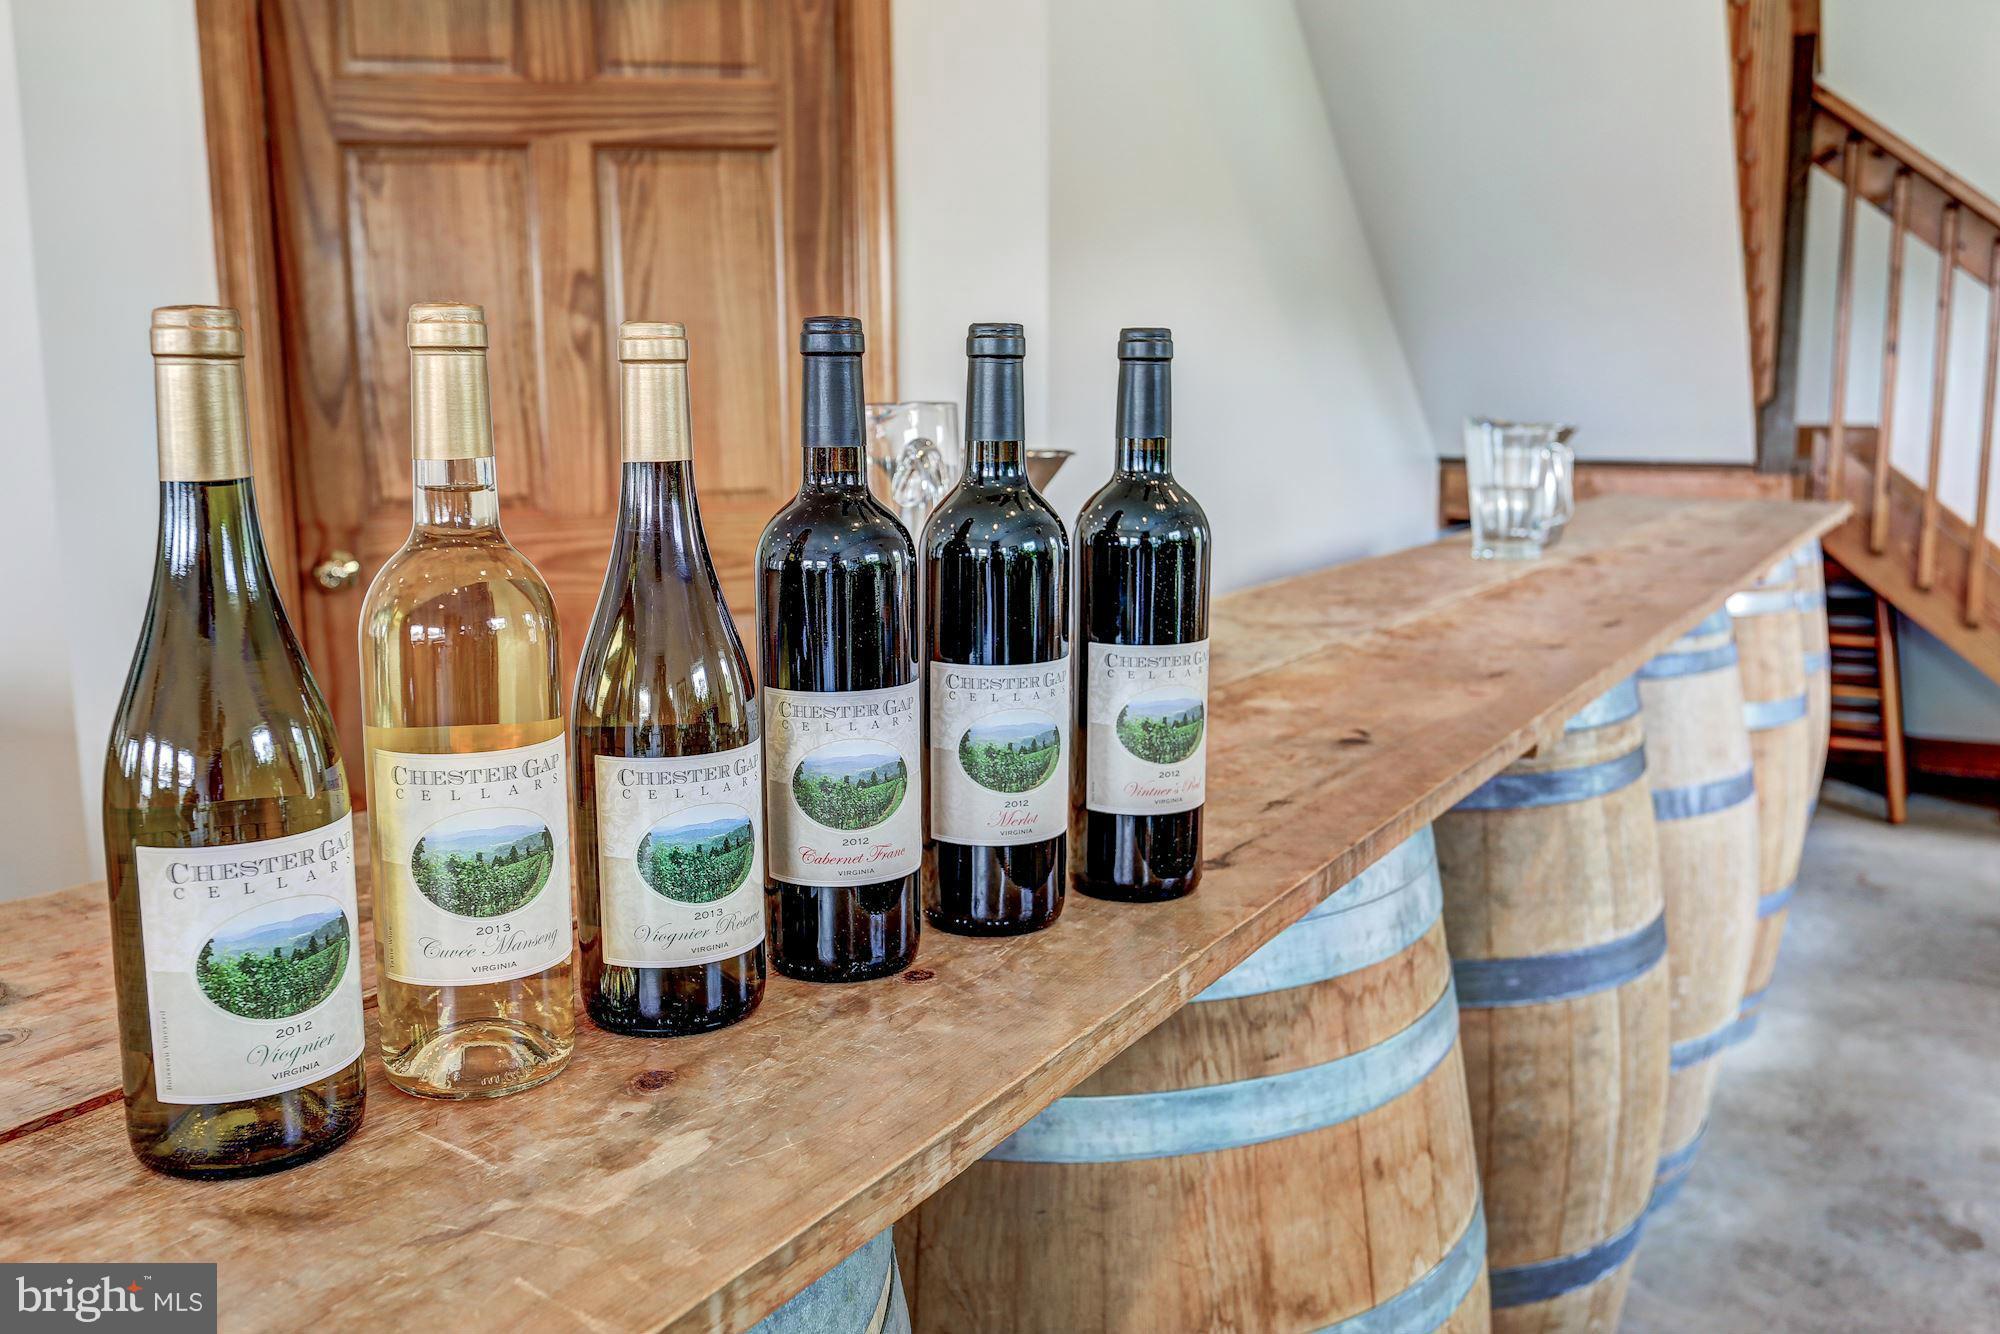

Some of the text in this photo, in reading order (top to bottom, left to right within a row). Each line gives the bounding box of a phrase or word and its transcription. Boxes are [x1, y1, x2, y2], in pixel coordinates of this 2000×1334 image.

[1104, 652, 1191, 668] CHESTER
[945, 673, 1040, 690] CHESTER
[778, 700, 880, 719] CHESTER
[883, 696, 914, 717] GAP
[781, 712, 913, 732] CELLARS
[391, 753, 560, 787] CHESTER GAP
[617, 754, 759, 786] CHESTER GAP
[1158, 770, 1181, 779] 2012
[395, 772, 559, 801] CELLARS
[622, 771, 758, 800] CELLARS
[1004, 800, 1030, 808] 2012
[987, 810, 1039, 828] Merlot
[841, 837, 870, 847] 2012
[1000, 828, 1033, 837] VIRGINIA
[168, 831, 351, 885] CHESTER GAP
[798, 842, 906, 865] Cabernet Franc
[837, 867, 875, 877] VIRGINIA
[694, 907, 724, 921] 2013
[475, 923, 512, 937] 2013
[633, 908, 760, 950] Viognier Reserve
[418, 927, 559, 960] Cuvée Manseng
[690, 941, 730, 954] VIRGINIA
[471, 961, 518, 974] VIRGINIA
[160, 1011, 169, 1049] Vineyard
[275, 1020, 314, 1040] 2012
[246, 1031, 336, 1068] Viognier
[271, 1060, 321, 1081] VIRGINIA
